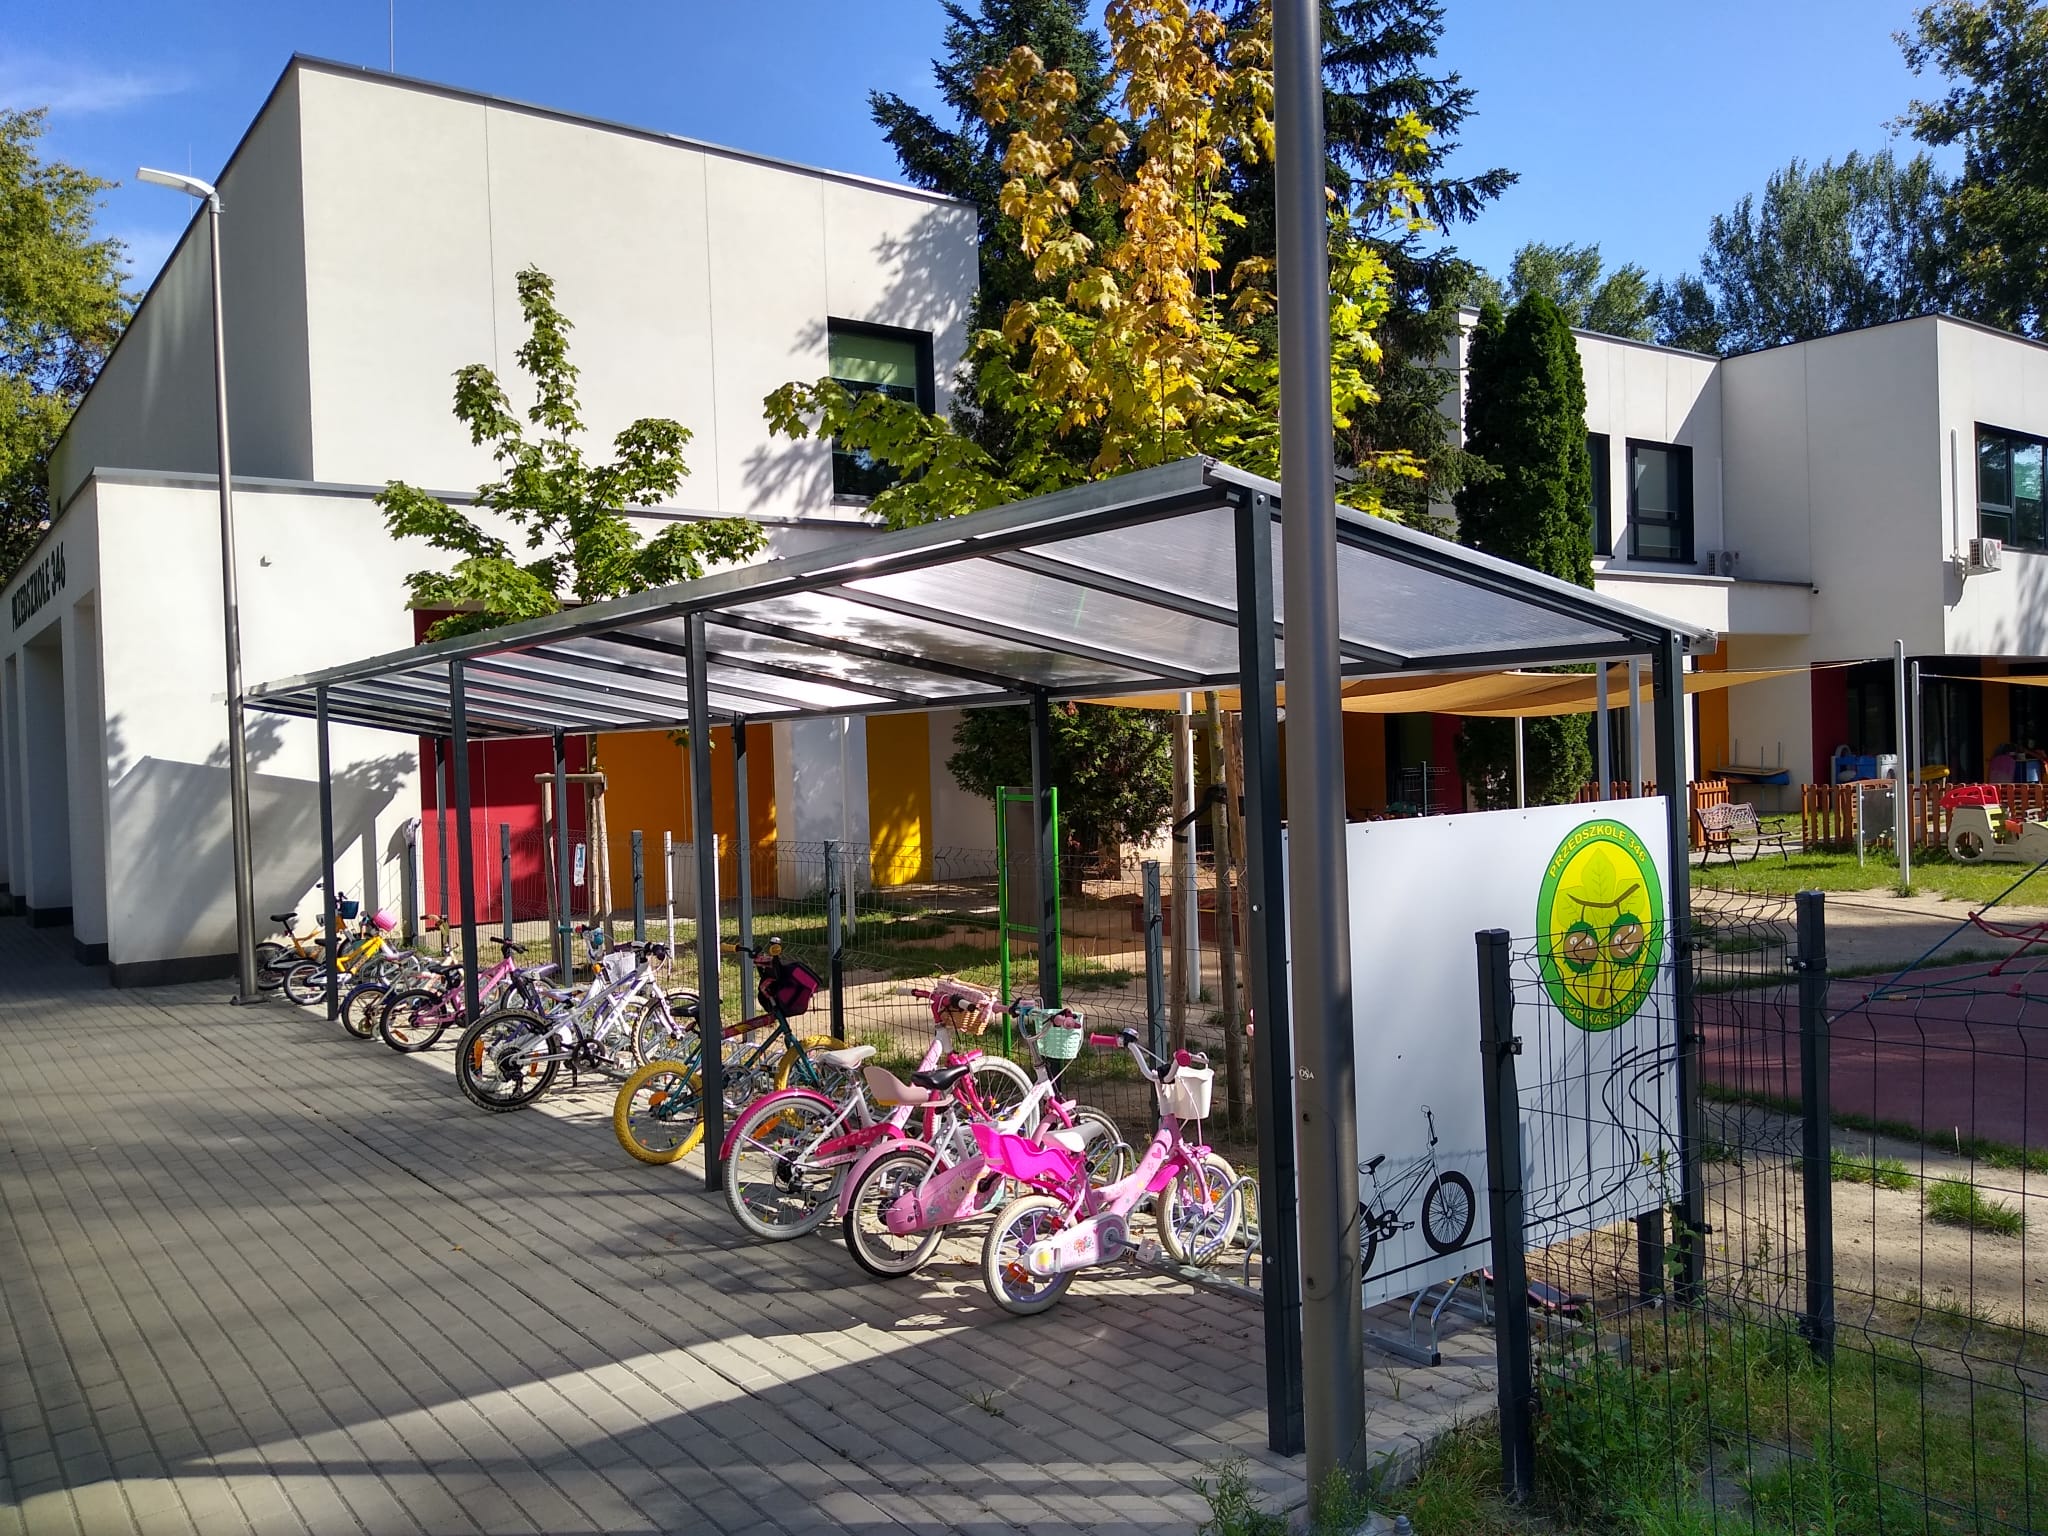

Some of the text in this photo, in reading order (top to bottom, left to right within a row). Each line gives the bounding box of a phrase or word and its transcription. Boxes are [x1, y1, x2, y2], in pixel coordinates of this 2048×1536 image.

[51, 541, 66, 597] 346
[1549, 825, 1647, 878] PRZEDSZKOLE 346
[1563, 996, 1583, 1019] POD
